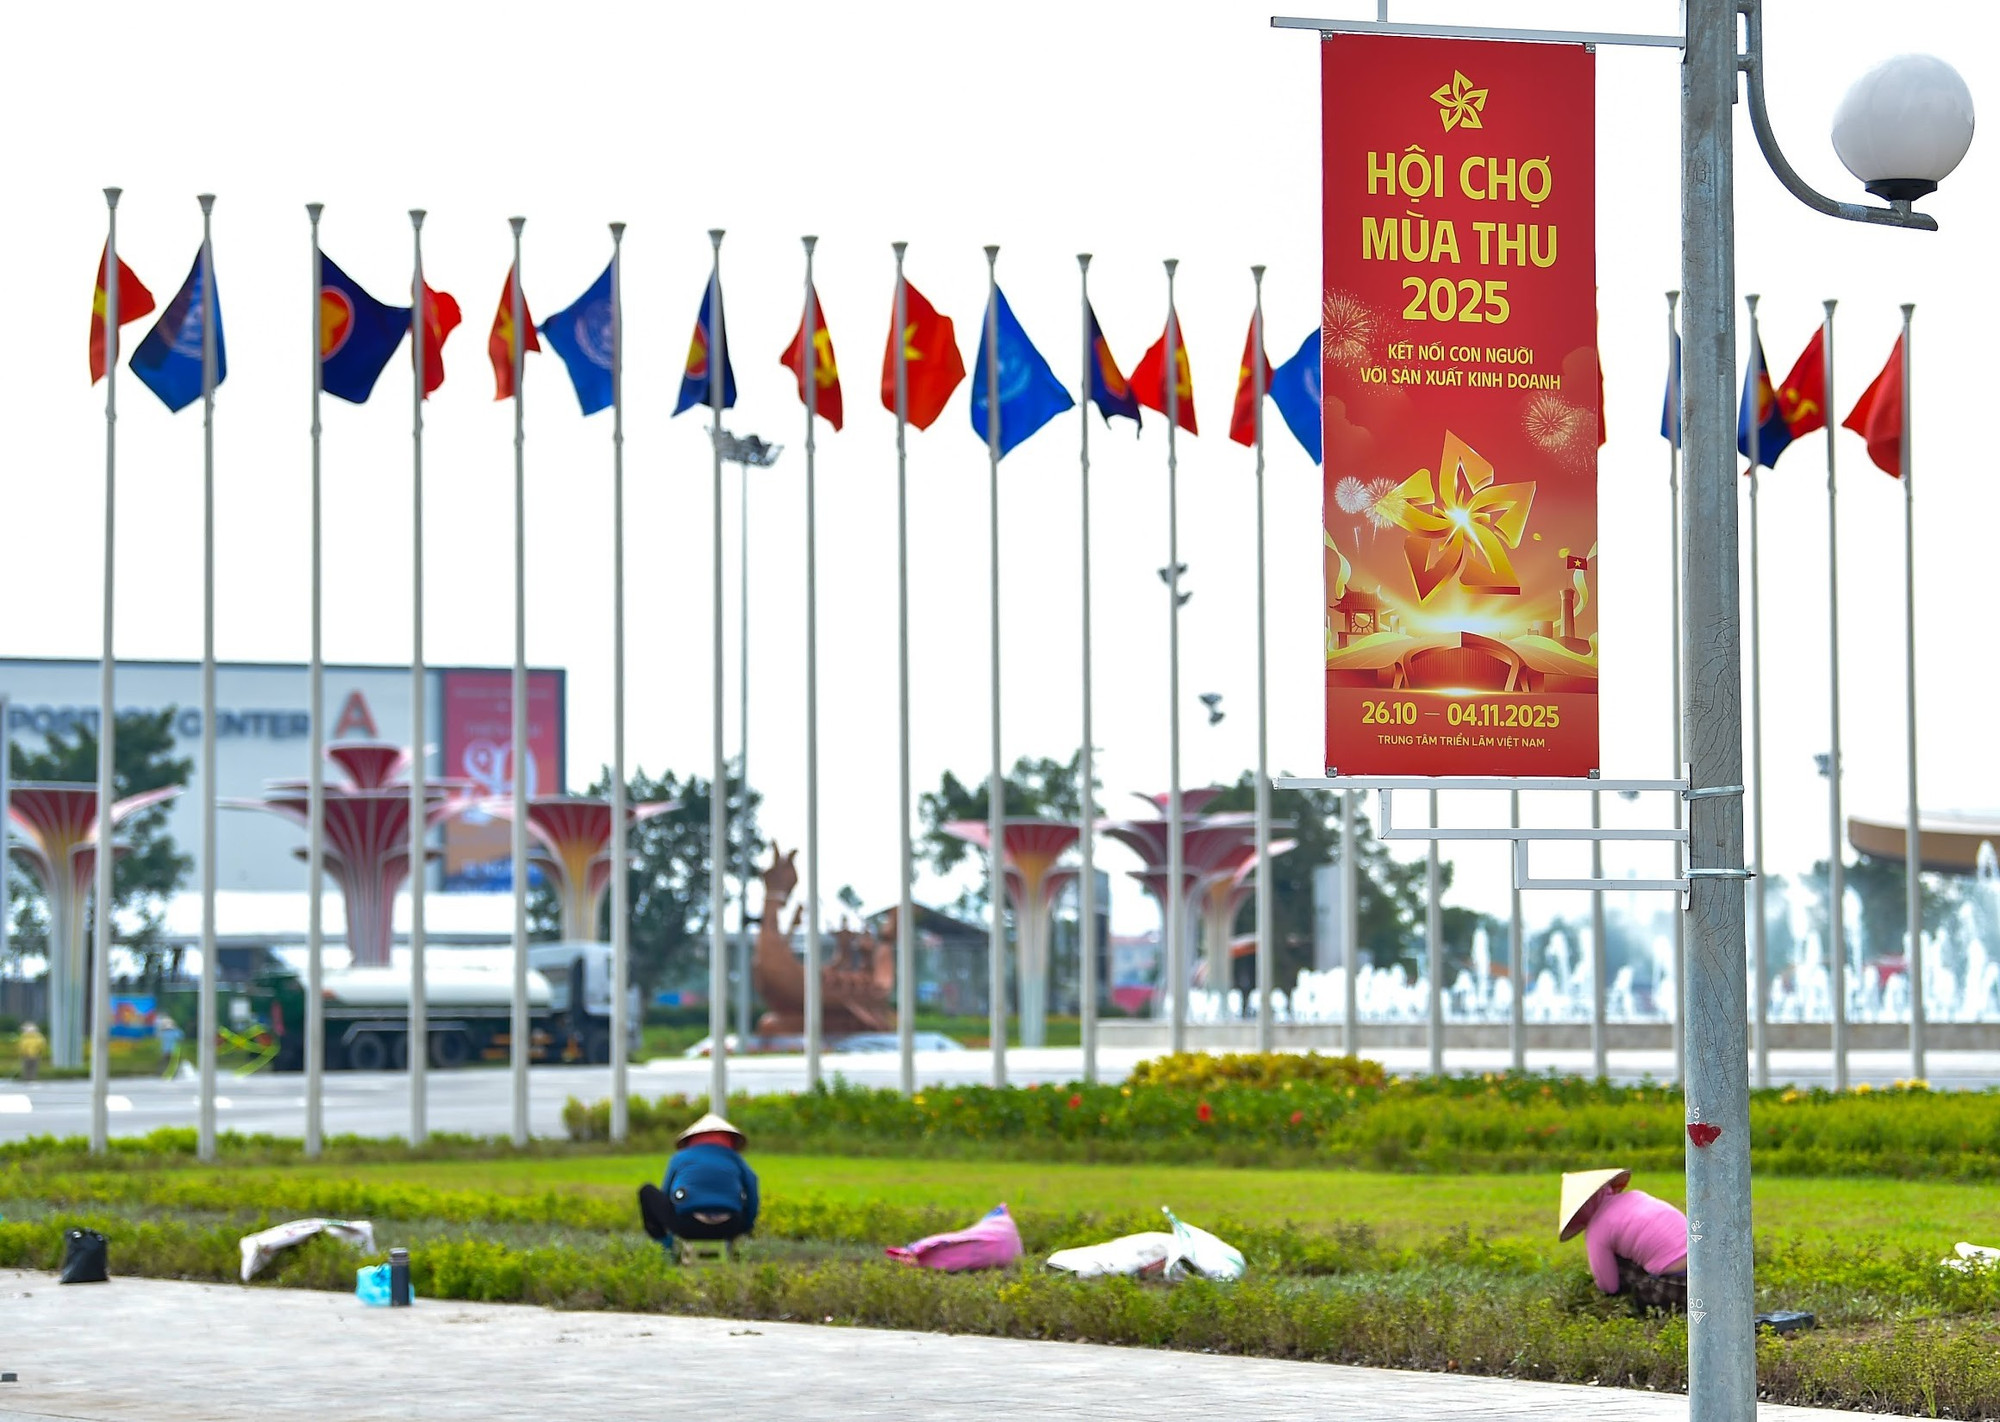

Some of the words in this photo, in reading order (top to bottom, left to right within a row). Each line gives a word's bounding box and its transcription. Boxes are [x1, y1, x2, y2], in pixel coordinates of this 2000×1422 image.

[1367, 144, 1444, 203] HỘI
[1459, 155, 1552, 208] CHỢ
[1362, 209, 1461, 263] MÙA
[1472, 221, 1557, 268] THU
[1402, 276, 1510, 324] 2025
[1388, 340, 1414, 360] KẾT
[1418, 341, 1445, 361] NỐI
[1449, 346, 1481, 363] CON
[1485, 346, 1534, 365] NGƯỜI
[1360, 364, 1387, 383] VỚI
[1391, 365, 1421, 385] SẢN
[1425, 366, 1464, 387] XUẤT
[1468, 371, 1503, 388] KINH
[1507, 373, 1561, 390] DOANH
[333, 689, 379, 738] A
[1362, 701, 1417, 725] 26.10
[1447, 703, 1560, 728] 04.11.2025
[1378, 734, 1413, 745] TRUNG
[1416, 733, 1437, 746] TÂM
[1440, 732, 1469, 747] TRIỂN
[1471, 734, 1495, 747] LÃM
[1496, 735, 1520, 750] VIỆT
[1521, 738, 1545, 748] NAM
